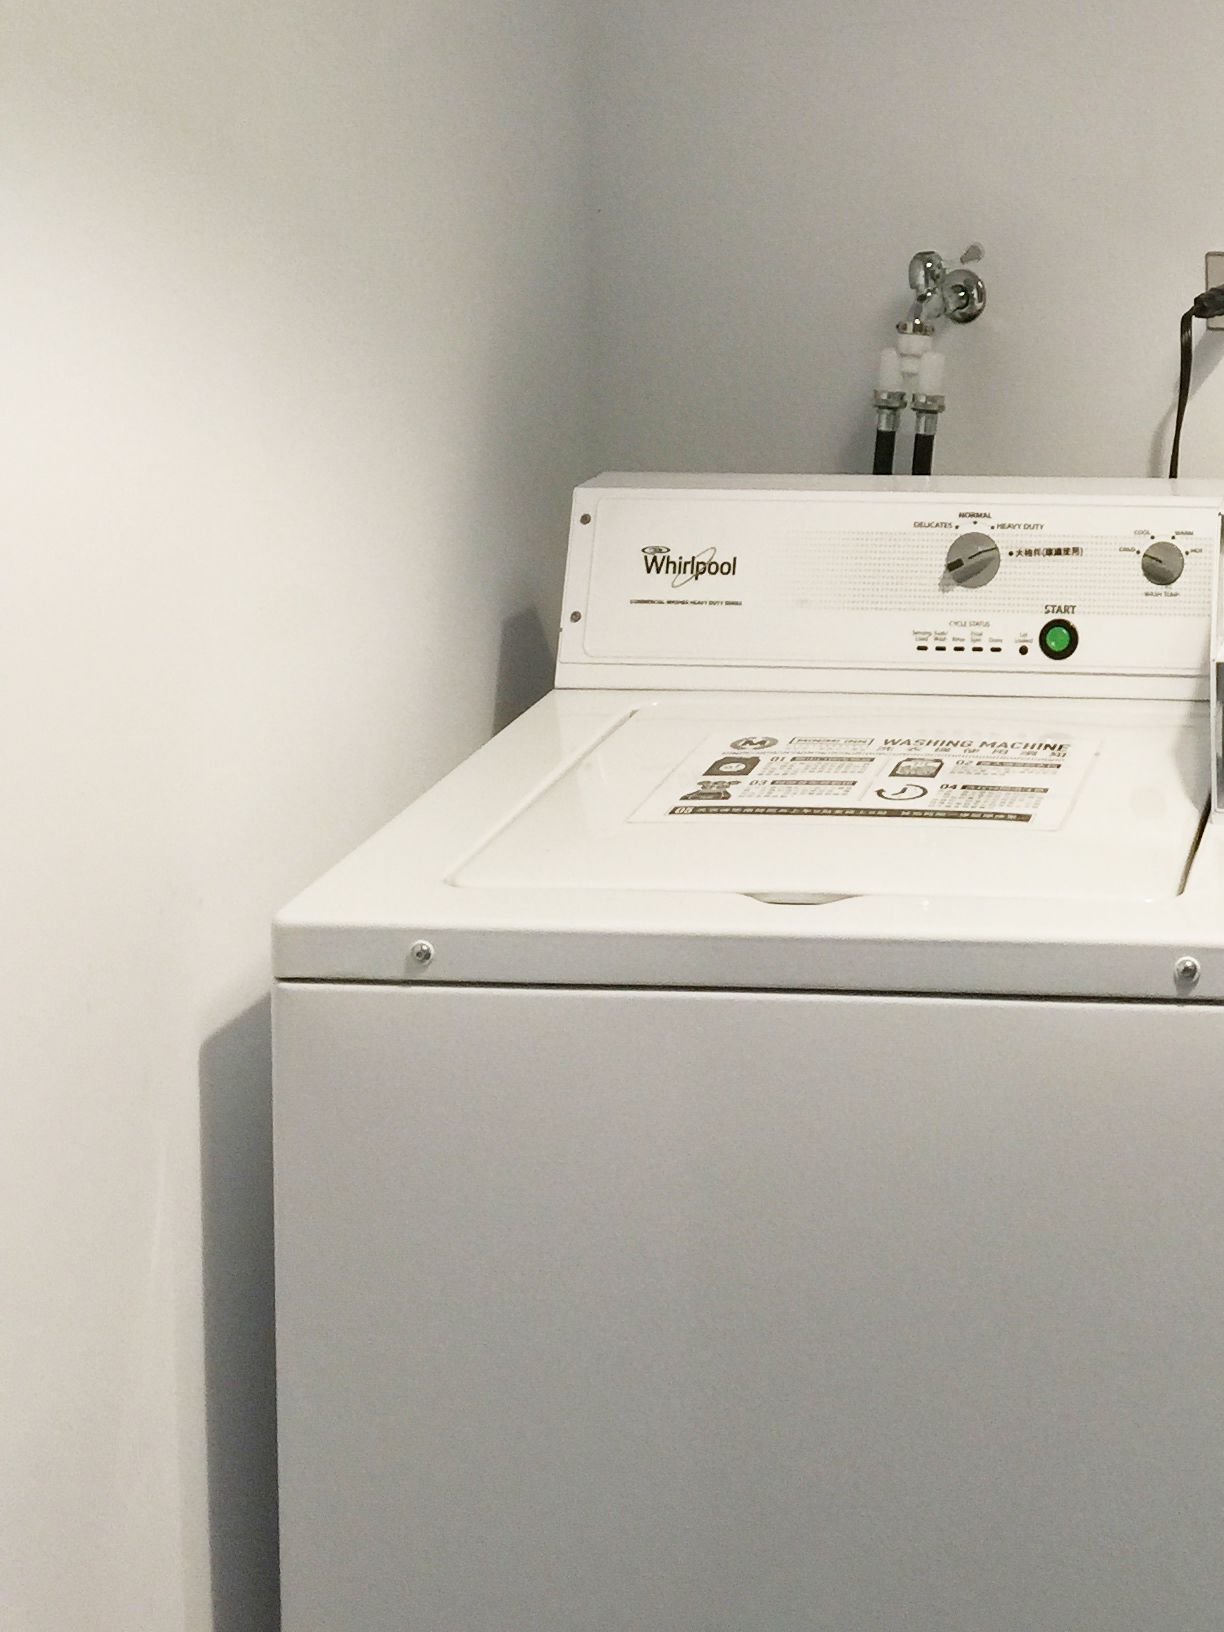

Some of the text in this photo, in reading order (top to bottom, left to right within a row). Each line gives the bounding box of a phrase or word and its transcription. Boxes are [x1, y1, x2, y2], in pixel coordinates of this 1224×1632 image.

[913, 521, 953, 529] DELICATES
[996, 523, 1044, 531] HEAVY DUTY
[644, 555, 737, 580] Whirlpool
[1044, 604, 1077, 615] START
[884, 738, 1071, 752] WASHING MACHINE
